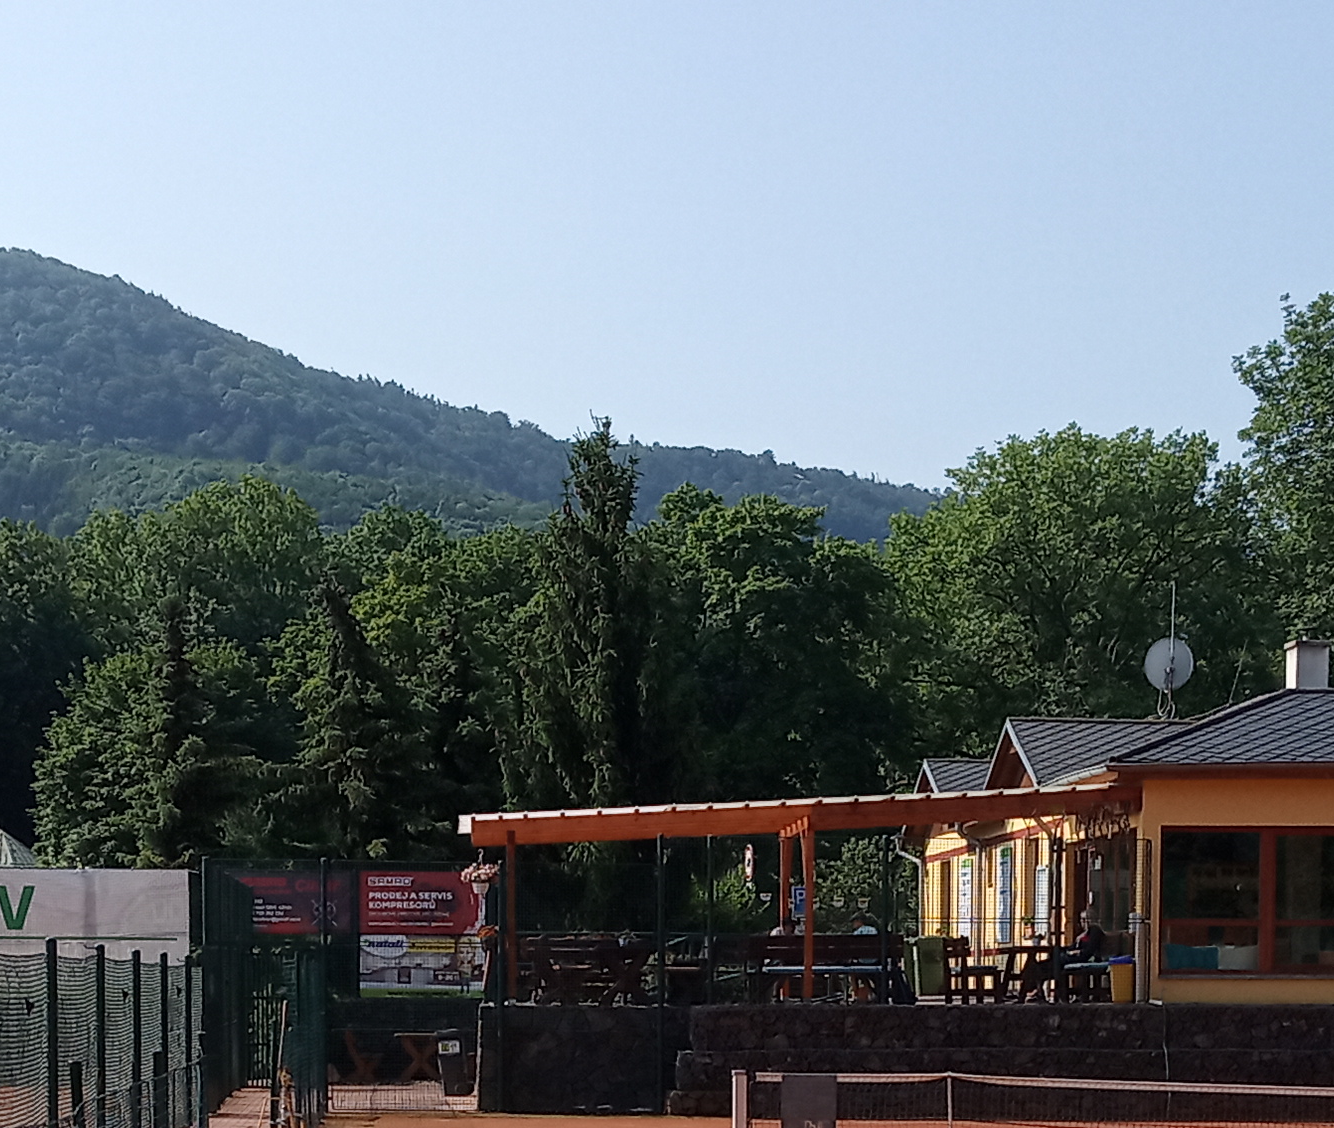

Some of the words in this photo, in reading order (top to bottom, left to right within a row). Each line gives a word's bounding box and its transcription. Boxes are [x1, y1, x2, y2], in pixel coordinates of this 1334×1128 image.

[368, 891, 408, 900] PRODEJ
[409, 891, 417, 900] A
[418, 891, 453, 900] SERVIS
[368, 899, 436, 909] KOMPRESORŮ
